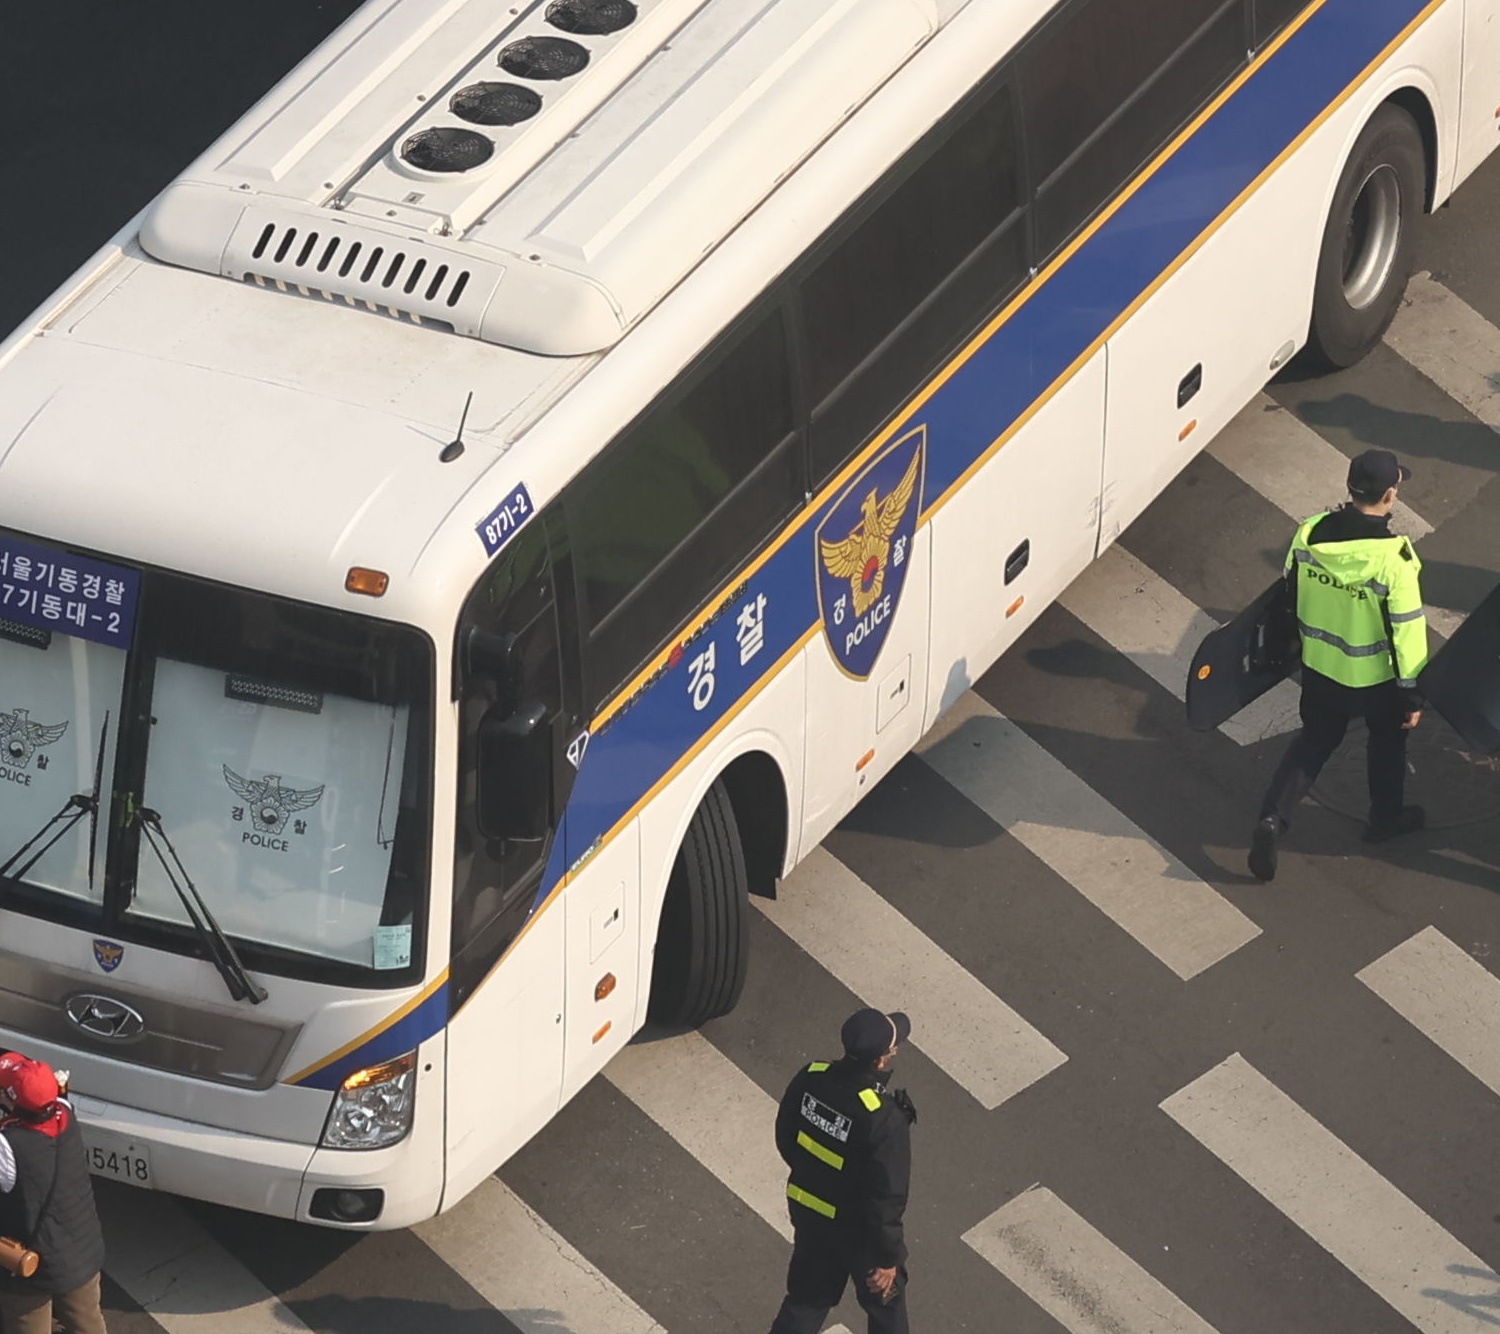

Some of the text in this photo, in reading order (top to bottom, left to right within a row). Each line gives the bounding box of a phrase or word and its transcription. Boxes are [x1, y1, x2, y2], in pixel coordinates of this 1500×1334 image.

[484, 493, 529, 545] 87기-2
[845, 595, 891, 657] POLICE
[241, 831, 290, 853] POLICE
